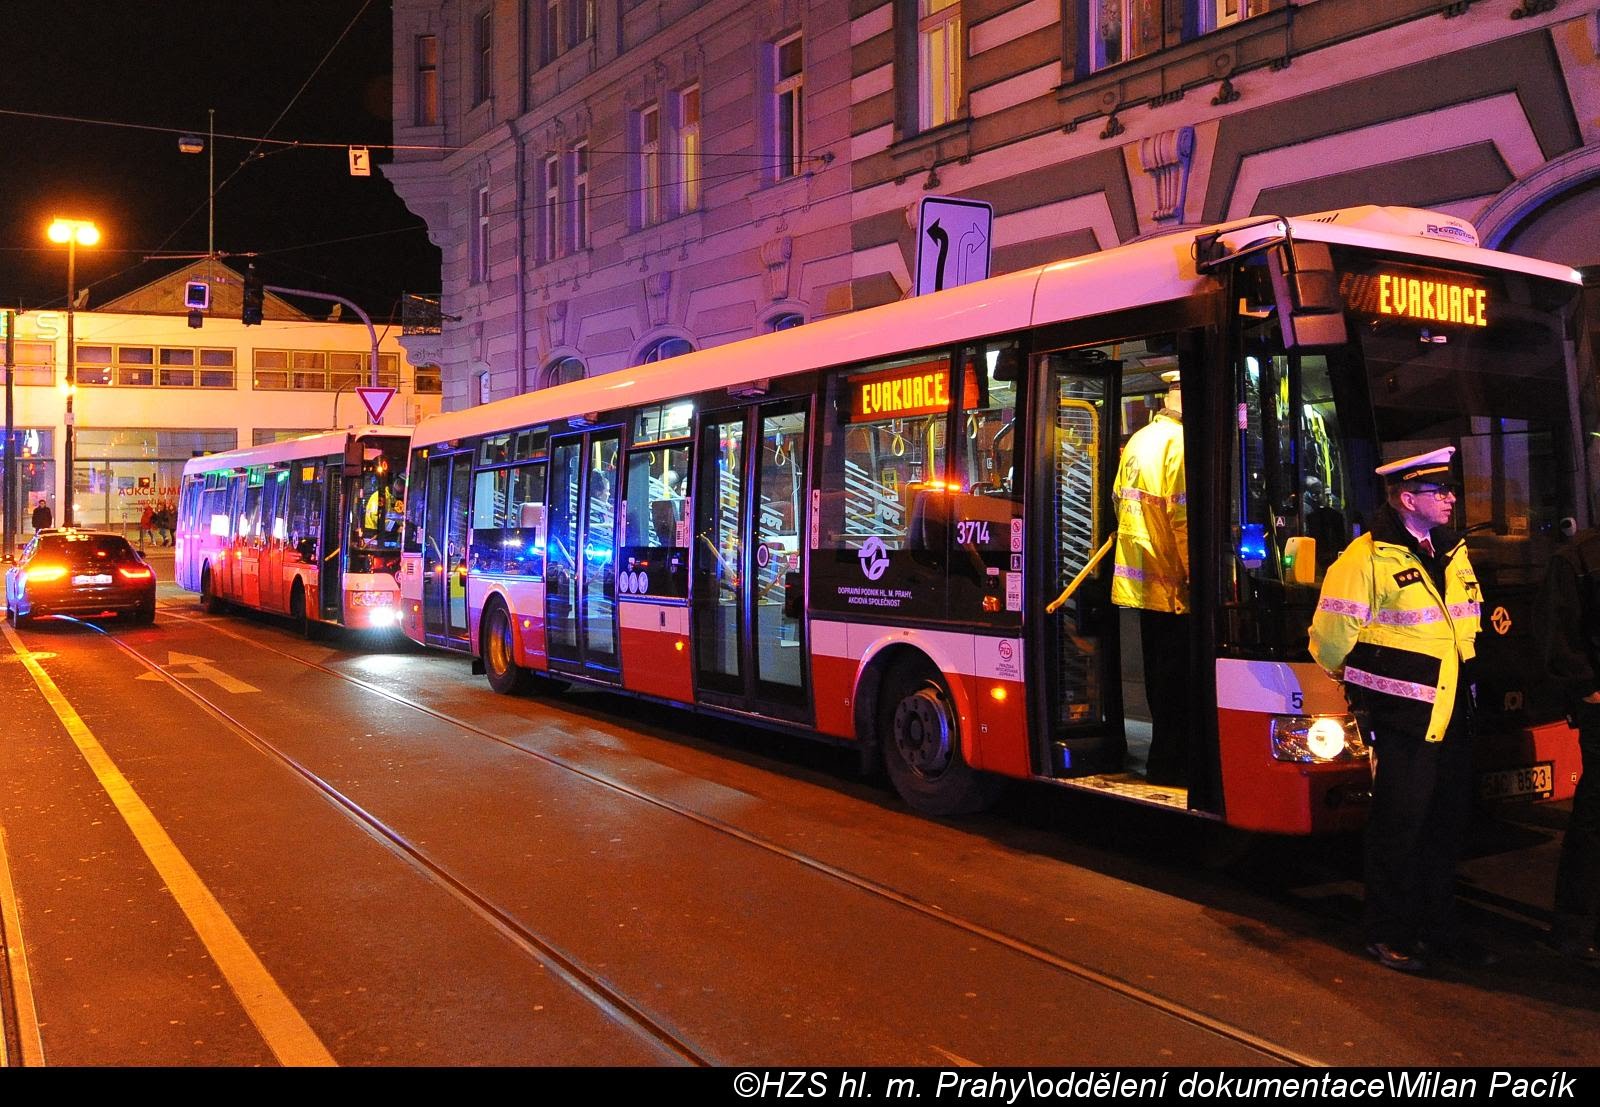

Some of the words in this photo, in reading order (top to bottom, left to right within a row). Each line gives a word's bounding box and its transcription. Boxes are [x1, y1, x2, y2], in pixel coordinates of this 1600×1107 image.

[1379, 274, 1487, 327] EVAKUACE
[863, 373, 946, 415] EVAKUACE
[119, 486, 155, 497] AUKCE
[956, 521, 990, 544] 3714
[861, 588, 880, 597] PODNIK
[868, 597, 900, 607] SPOLEČNOST
[1291, 691, 1304, 710] 5
